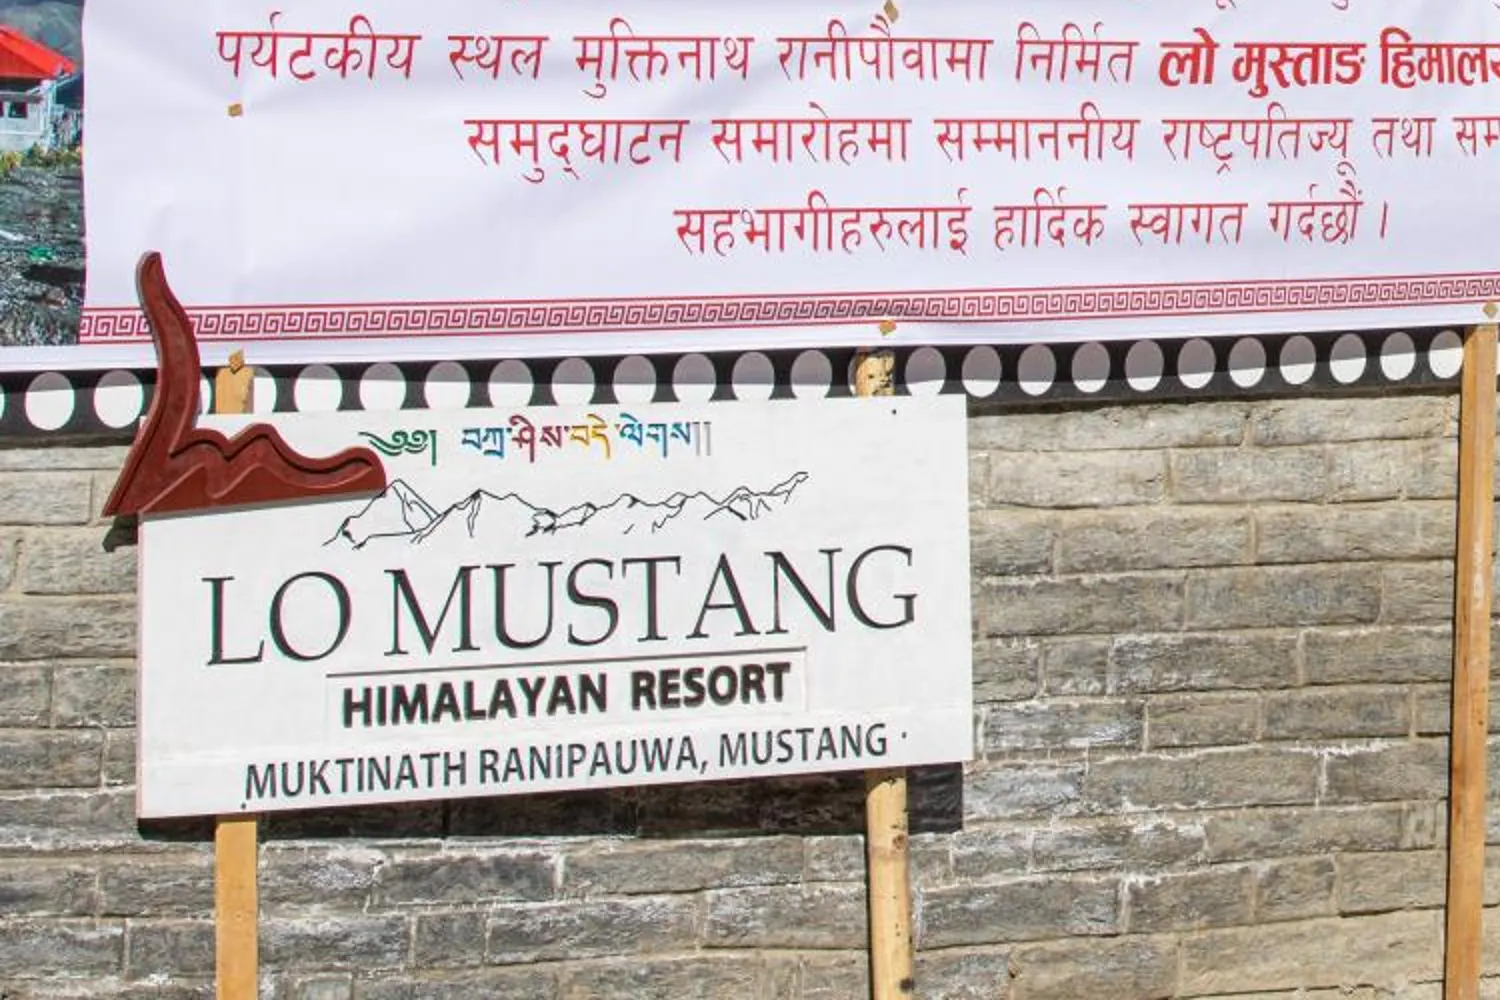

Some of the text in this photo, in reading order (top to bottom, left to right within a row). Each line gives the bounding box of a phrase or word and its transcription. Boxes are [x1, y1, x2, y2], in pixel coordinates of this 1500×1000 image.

[215, 10, 425, 83] पर्यटकीय
[446, 32, 552, 80] स्थल
[574, 16, 757, 99] मुक्तिनाथ
[775, 14, 994, 83] रानीपौवामा
[1014, 21, 1141, 85] निर्मित
[1157, 25, 1223, 90] लो
[1230, 38, 1370, 102] मुस्ताङ
[709, 100, 912, 165] समारोहमा
[931, 98, 1142, 163] सम्माननीय
[1161, 101, 1353, 177] राष्ट्रपतिज्यू
[1372, 113, 1437, 159] तथा
[993, 185, 1106, 249] हार्दिक
[1127, 200, 1249, 246] स्वागत
[201, 545, 917, 666] LO MUSTANG
[341, 662, 791, 728] HIMALAYAN RESORT
[245, 723, 889, 801] MUKTINATH RANIPAUWA, MUSTANG
